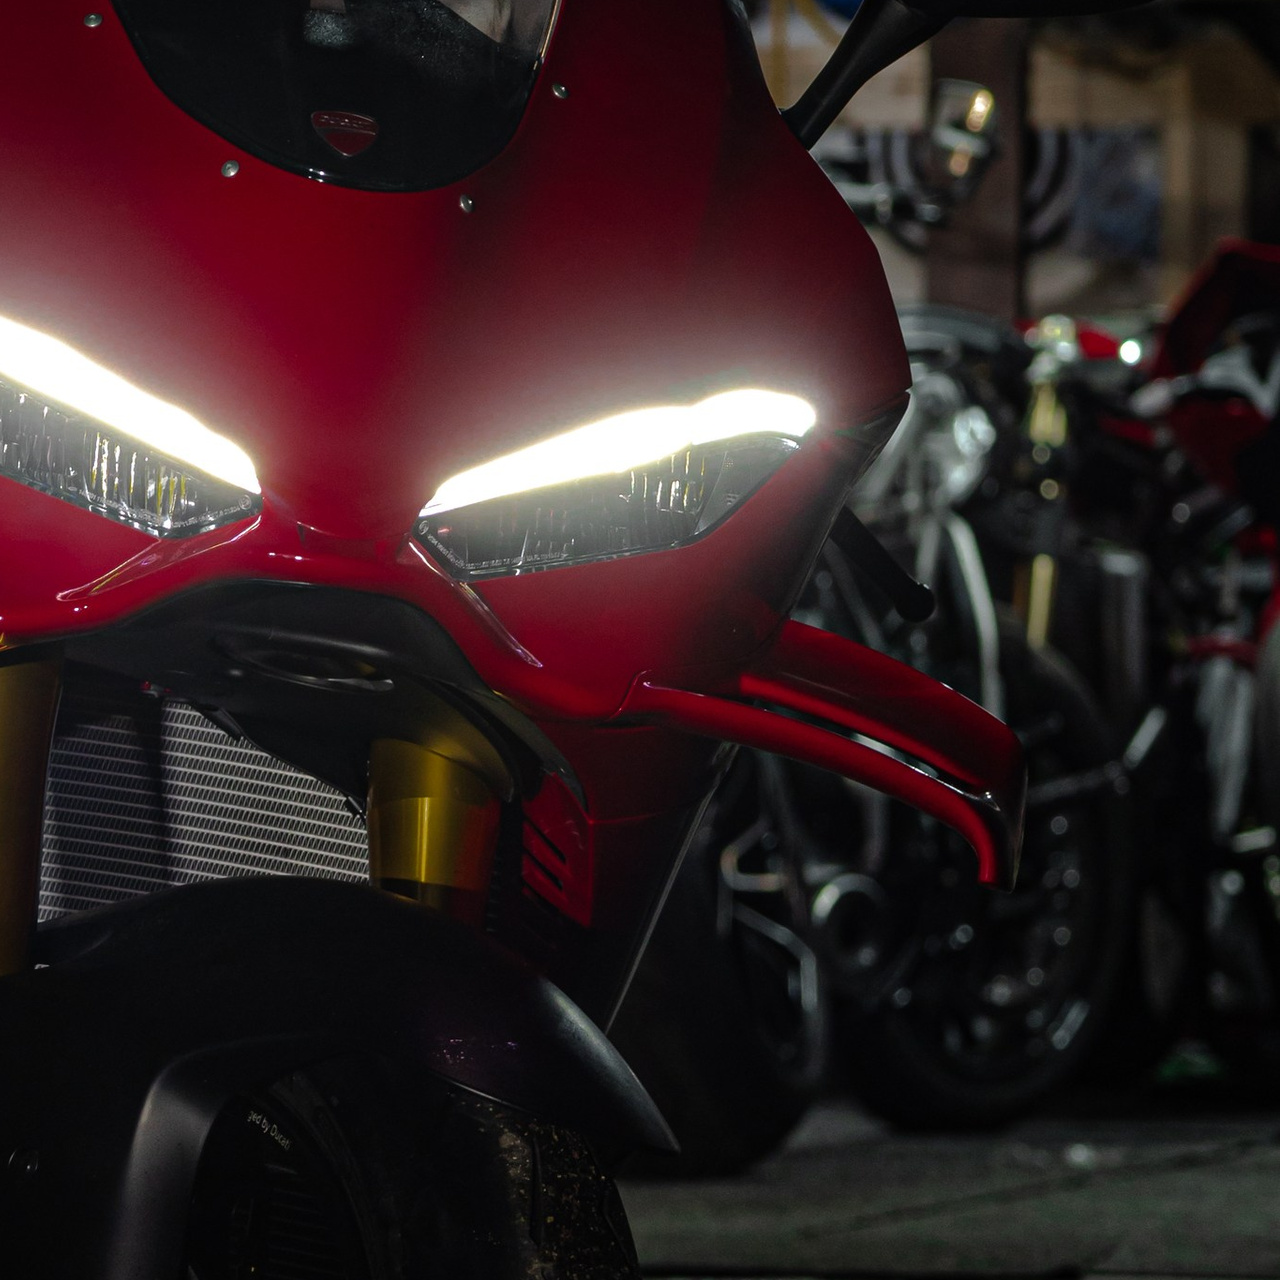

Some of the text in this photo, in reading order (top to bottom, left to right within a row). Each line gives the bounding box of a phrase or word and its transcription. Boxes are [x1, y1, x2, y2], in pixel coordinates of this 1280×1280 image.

[247, 1110, 290, 1150] ged by Ducati
